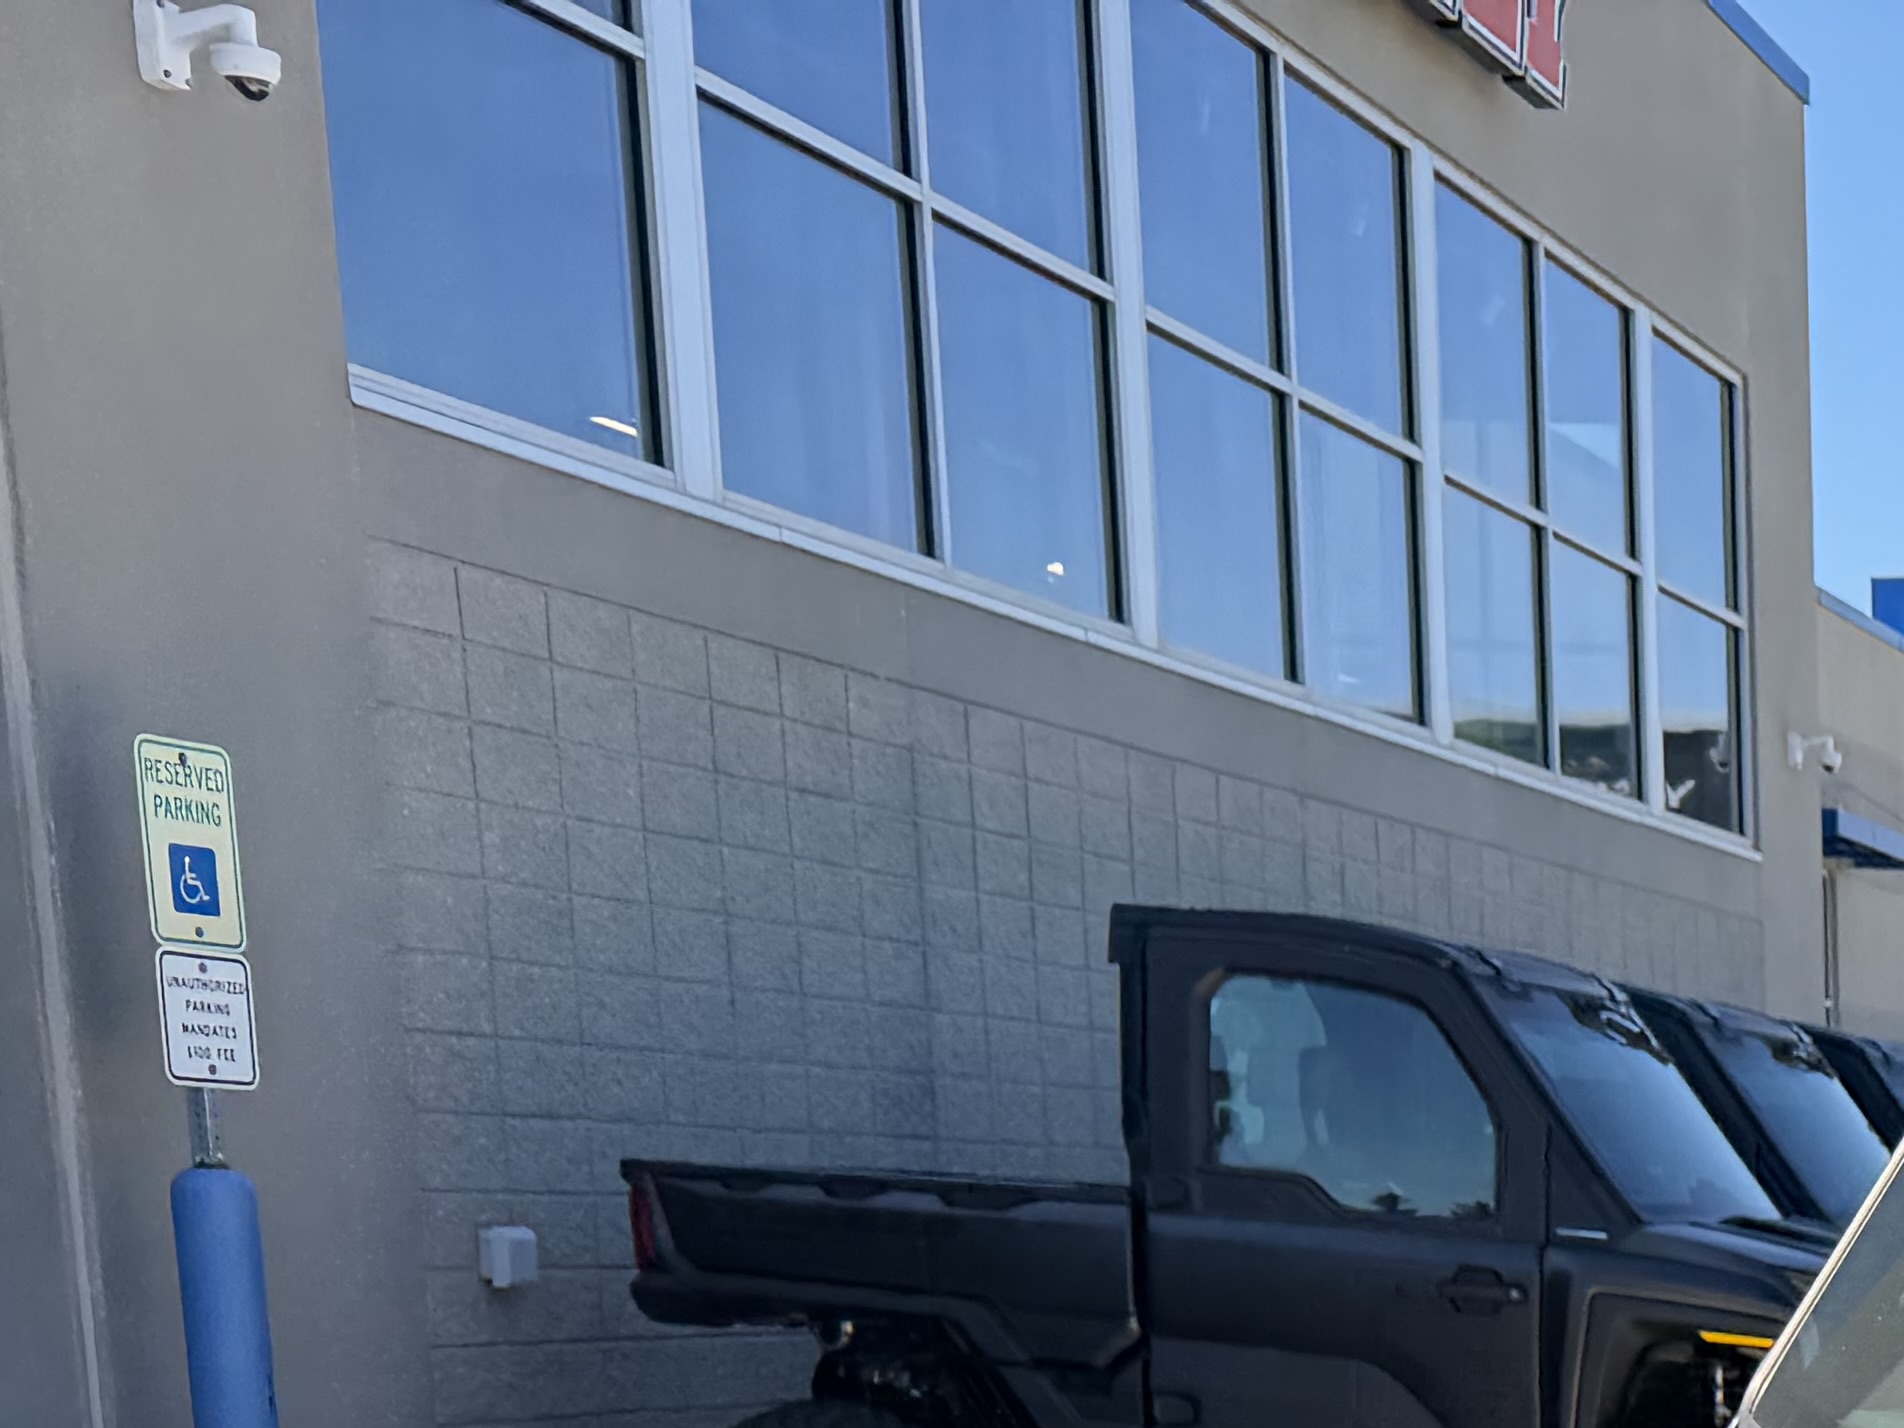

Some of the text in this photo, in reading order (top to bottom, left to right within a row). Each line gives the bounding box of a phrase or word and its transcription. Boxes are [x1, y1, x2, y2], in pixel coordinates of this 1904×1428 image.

[143, 756, 224, 793] RESERVED
[153, 794, 222, 827] PARKING
[185, 999, 230, 1016] PARKING
